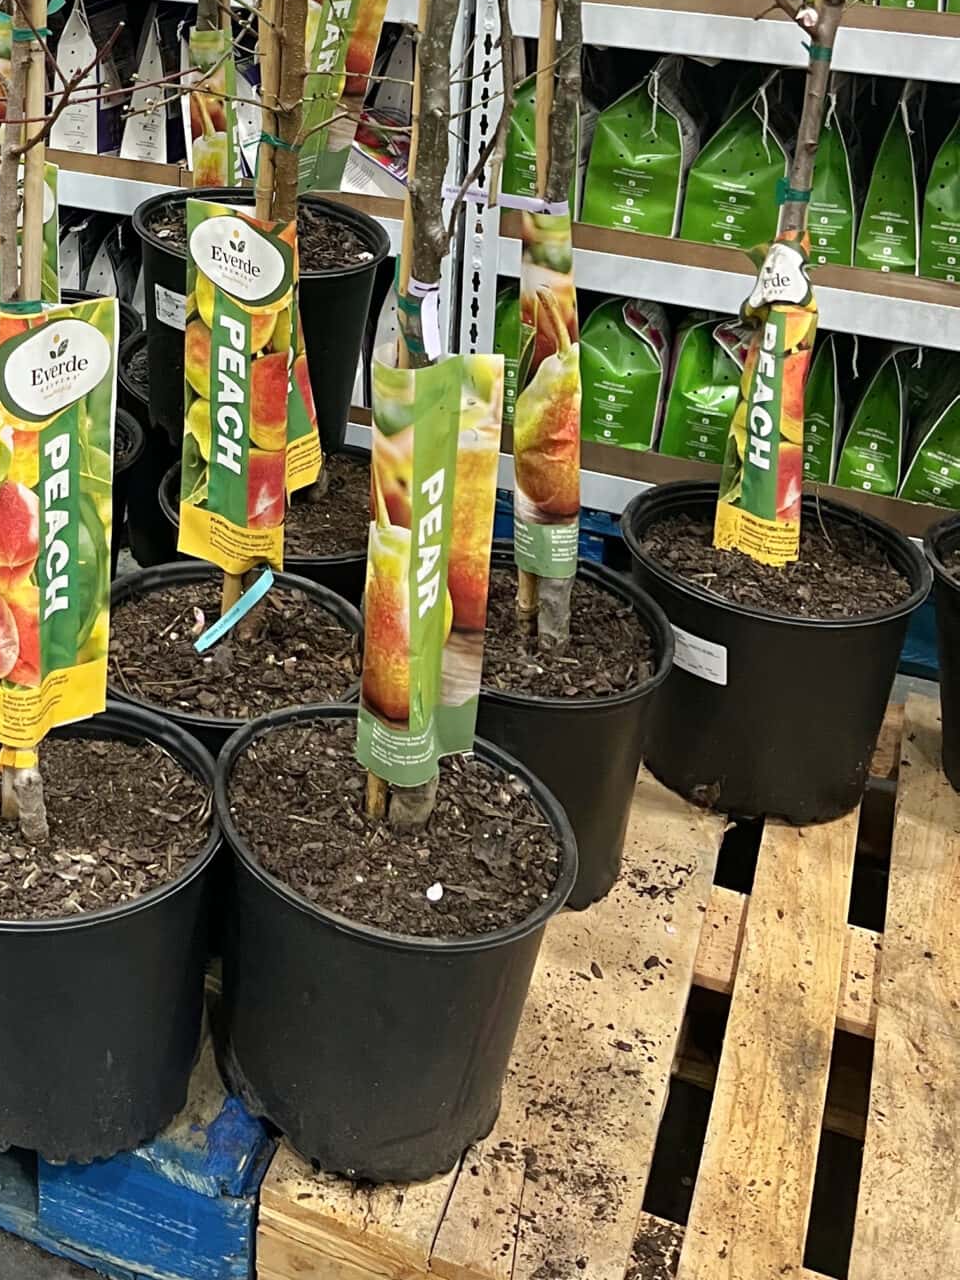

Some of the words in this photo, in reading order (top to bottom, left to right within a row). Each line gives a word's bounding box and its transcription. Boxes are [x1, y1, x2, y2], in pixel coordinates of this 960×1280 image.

[211, 245, 261, 278] Everde
[31, 354, 89, 387] Everde
[216, 313, 248, 476] PEACH
[748, 322, 778, 471] PEACH
[43, 432, 70, 621] PEACH
[417, 467, 446, 620] PEAR
